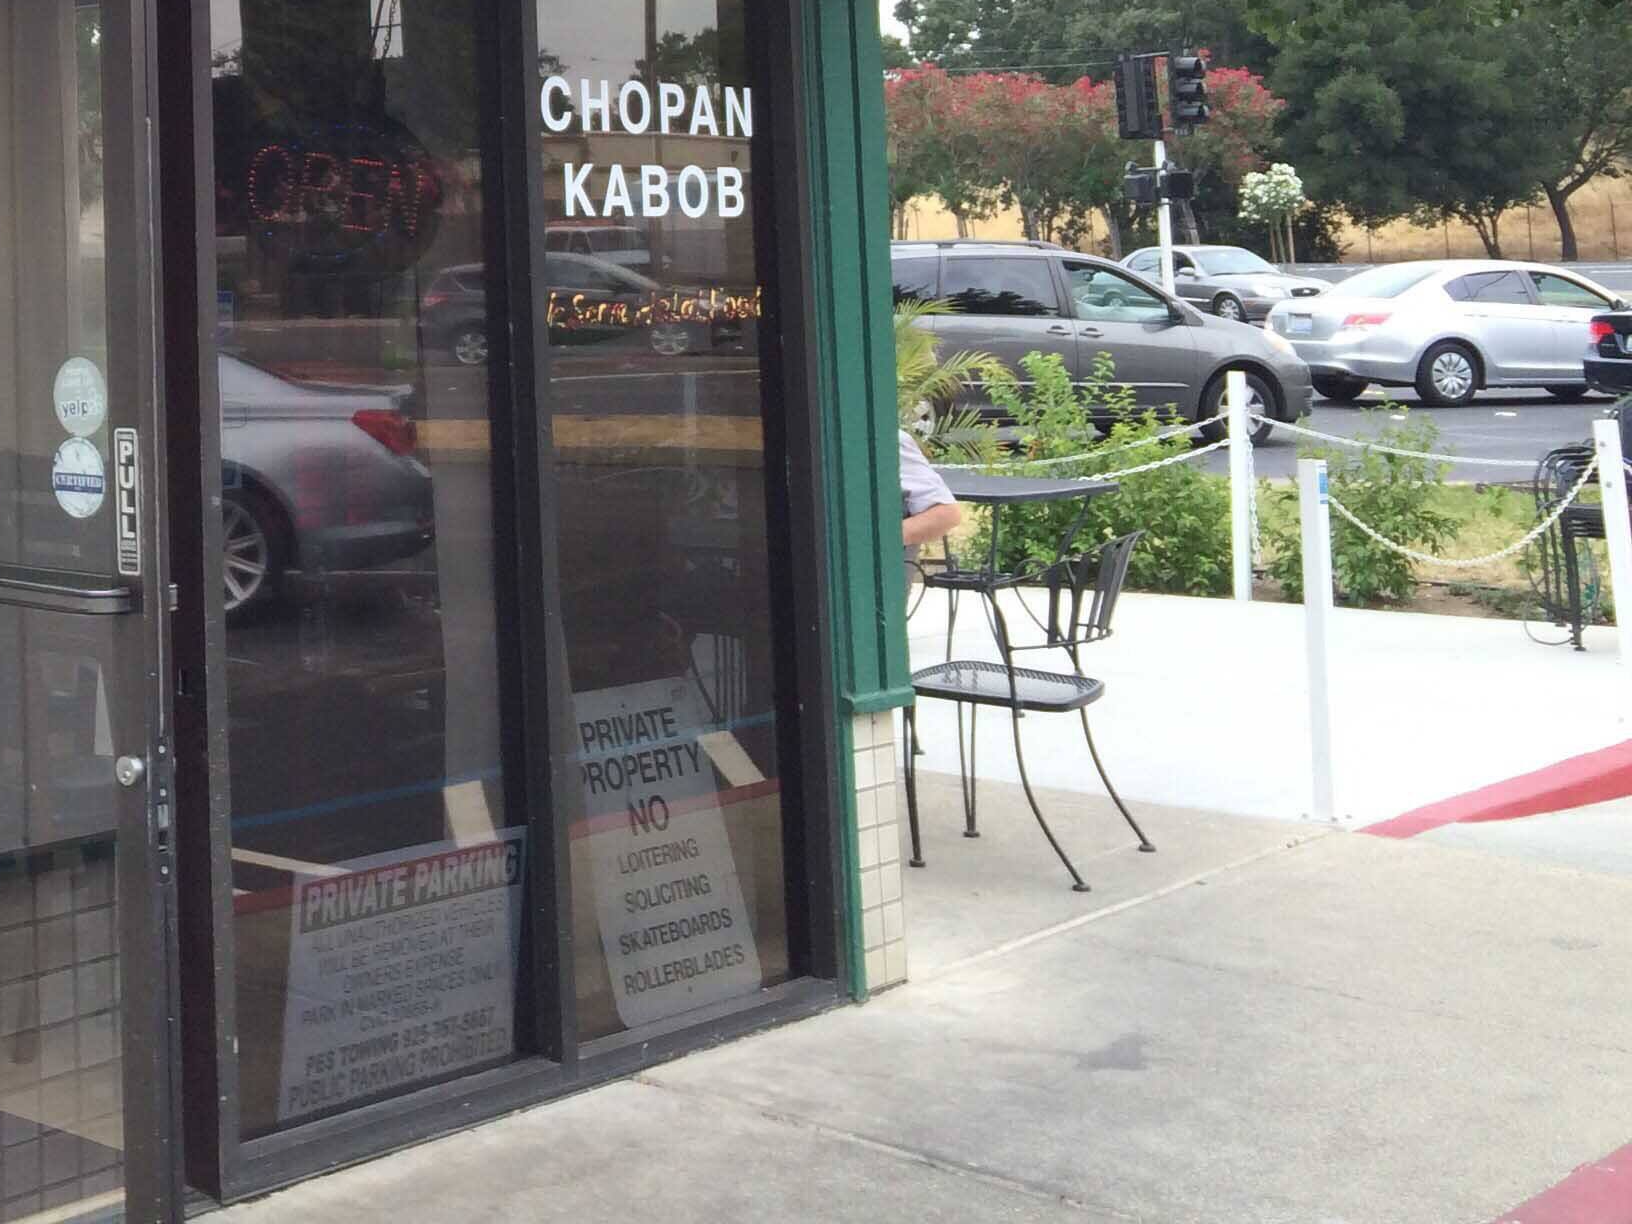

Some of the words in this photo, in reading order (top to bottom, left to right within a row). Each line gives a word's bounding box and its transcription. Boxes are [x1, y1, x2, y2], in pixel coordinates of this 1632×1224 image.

[541, 76, 753, 137] CHOPAN
[247, 144, 425, 236] OPEN
[564, 163, 745, 218] KABOB
[61, 400, 89, 418] yelp
[55, 473, 103, 489] CERTIFIED
[119, 440, 136, 539] PULL
[579, 707, 678, 754] PRIVATE
[629, 795, 669, 836] NO
[617, 838, 701, 875] LOITERING
[306, 866, 408, 925] PRIVATE
[414, 843, 518, 903] PARKING
[624, 875, 712, 914] SOLICITING
[351, 951, 369, 968] BE
[440, 927, 456, 946] AT
[619, 908, 734, 956] SKATEBOARDS
[404, 946, 465, 979] EXPENSE
[624, 944, 745, 996] ROLLERBLADES
[303, 1005, 337, 1026] PARK
[287, 1069, 346, 1113] PUBLIC
[348, 1050, 418, 1091] PARKING
[420, 1026, 508, 1075] PROHIBITED
[338, 1032, 399, 1067] TOWING
